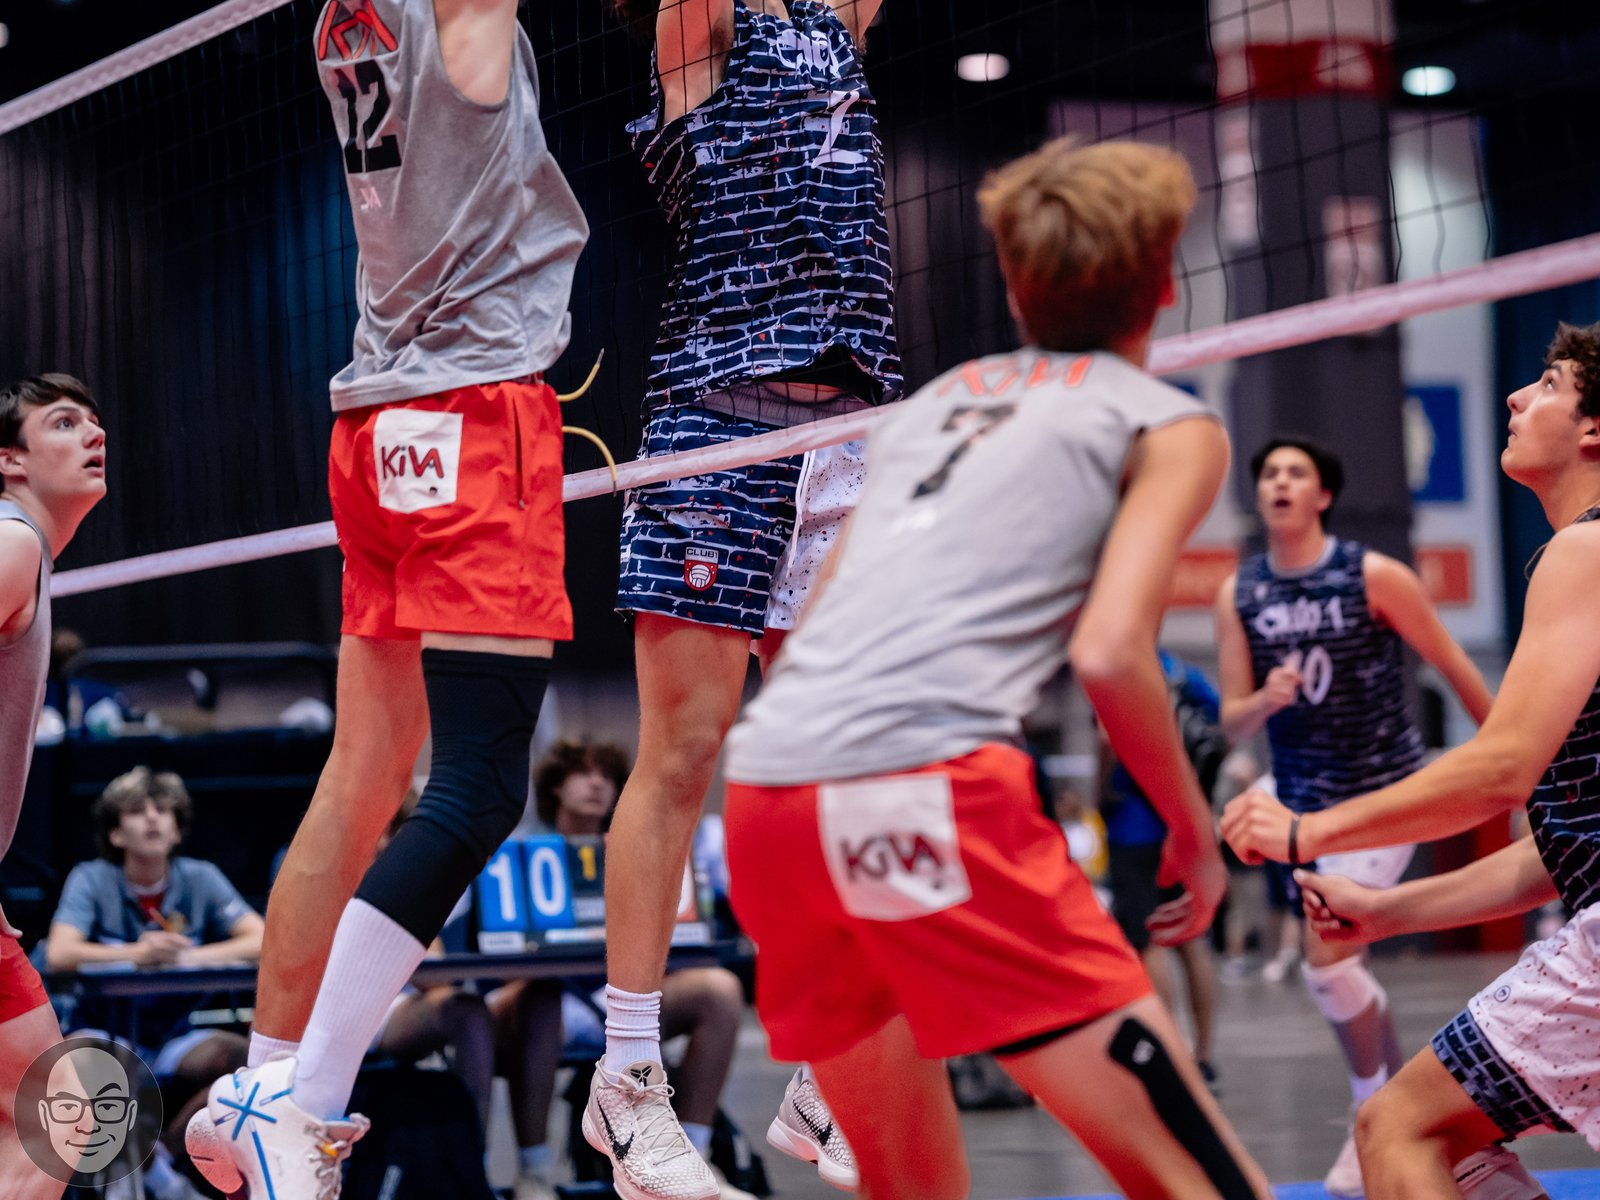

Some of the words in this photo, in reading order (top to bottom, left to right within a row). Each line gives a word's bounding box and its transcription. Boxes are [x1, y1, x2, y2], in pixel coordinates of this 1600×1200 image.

[333, 59, 402, 174] 12
[911, 404, 1017, 500] 7
[487, 847, 567, 922] 10
[579, 846, 596, 881] 1
